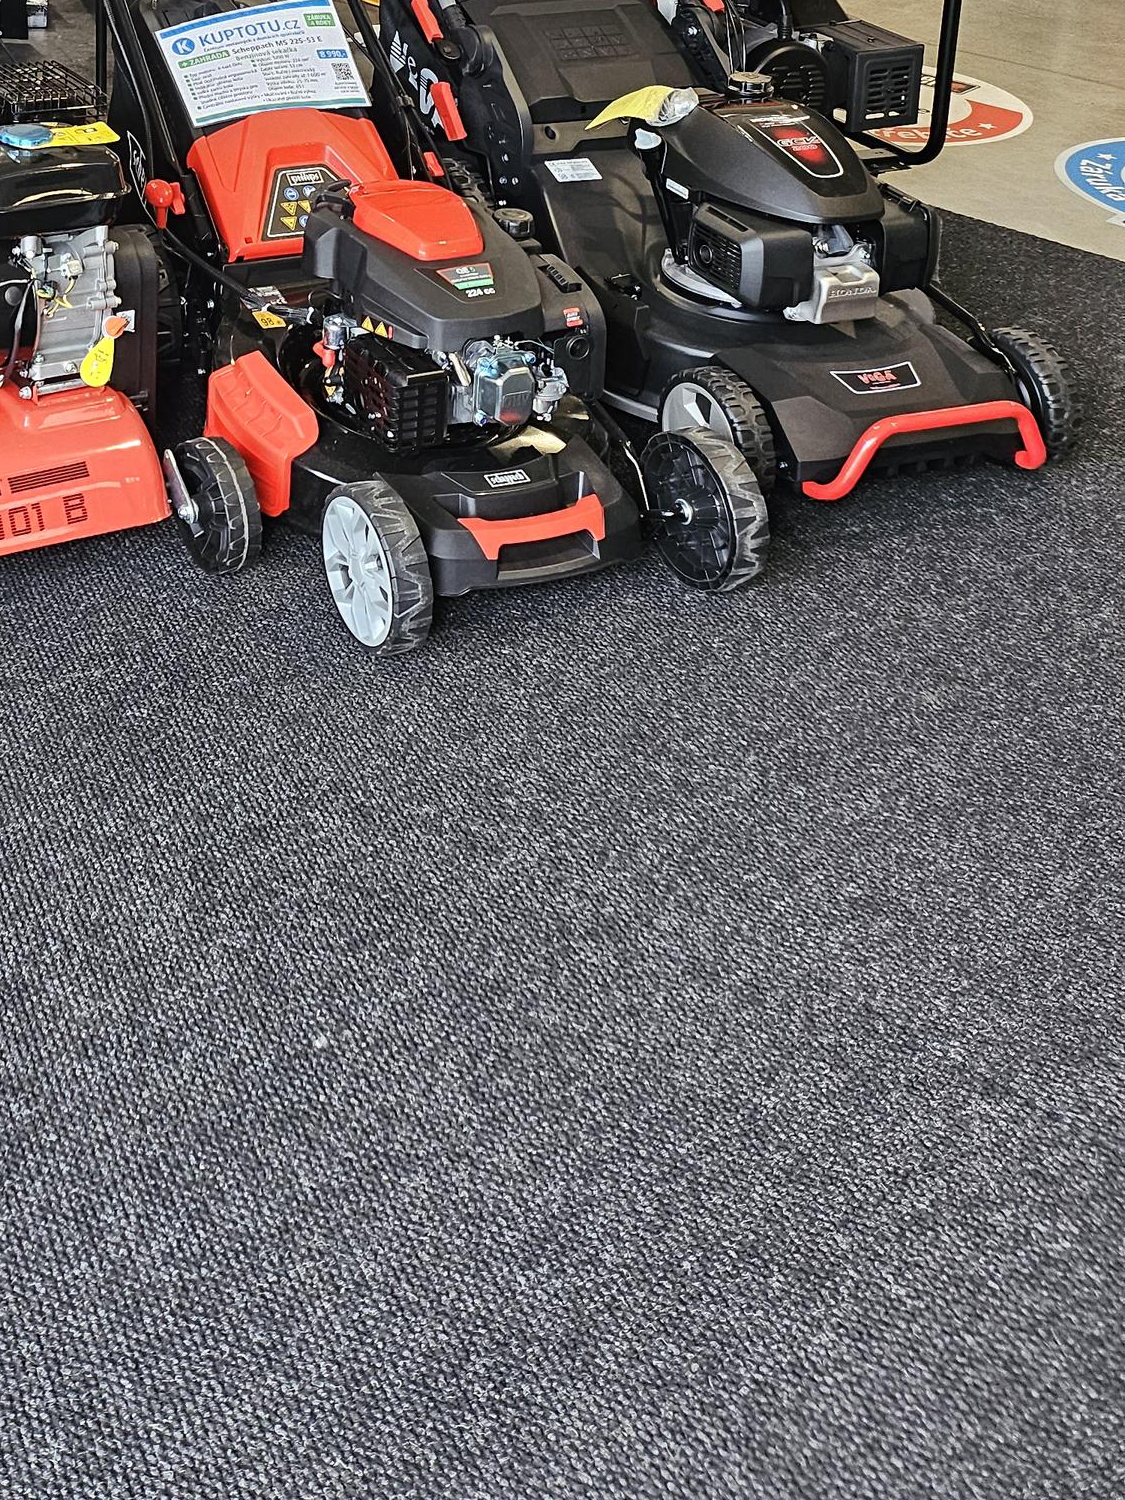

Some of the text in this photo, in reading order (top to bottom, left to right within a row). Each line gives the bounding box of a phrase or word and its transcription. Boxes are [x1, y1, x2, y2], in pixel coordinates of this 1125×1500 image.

[190, 51, 228, 64] ZAHRADA
[232, 41, 274, 55] Scheppach
[275, 39, 288, 47] MS
[466, 289, 483, 298] 224
[829, 287, 876, 298] HONDA
[63, 492, 88, 525] B
